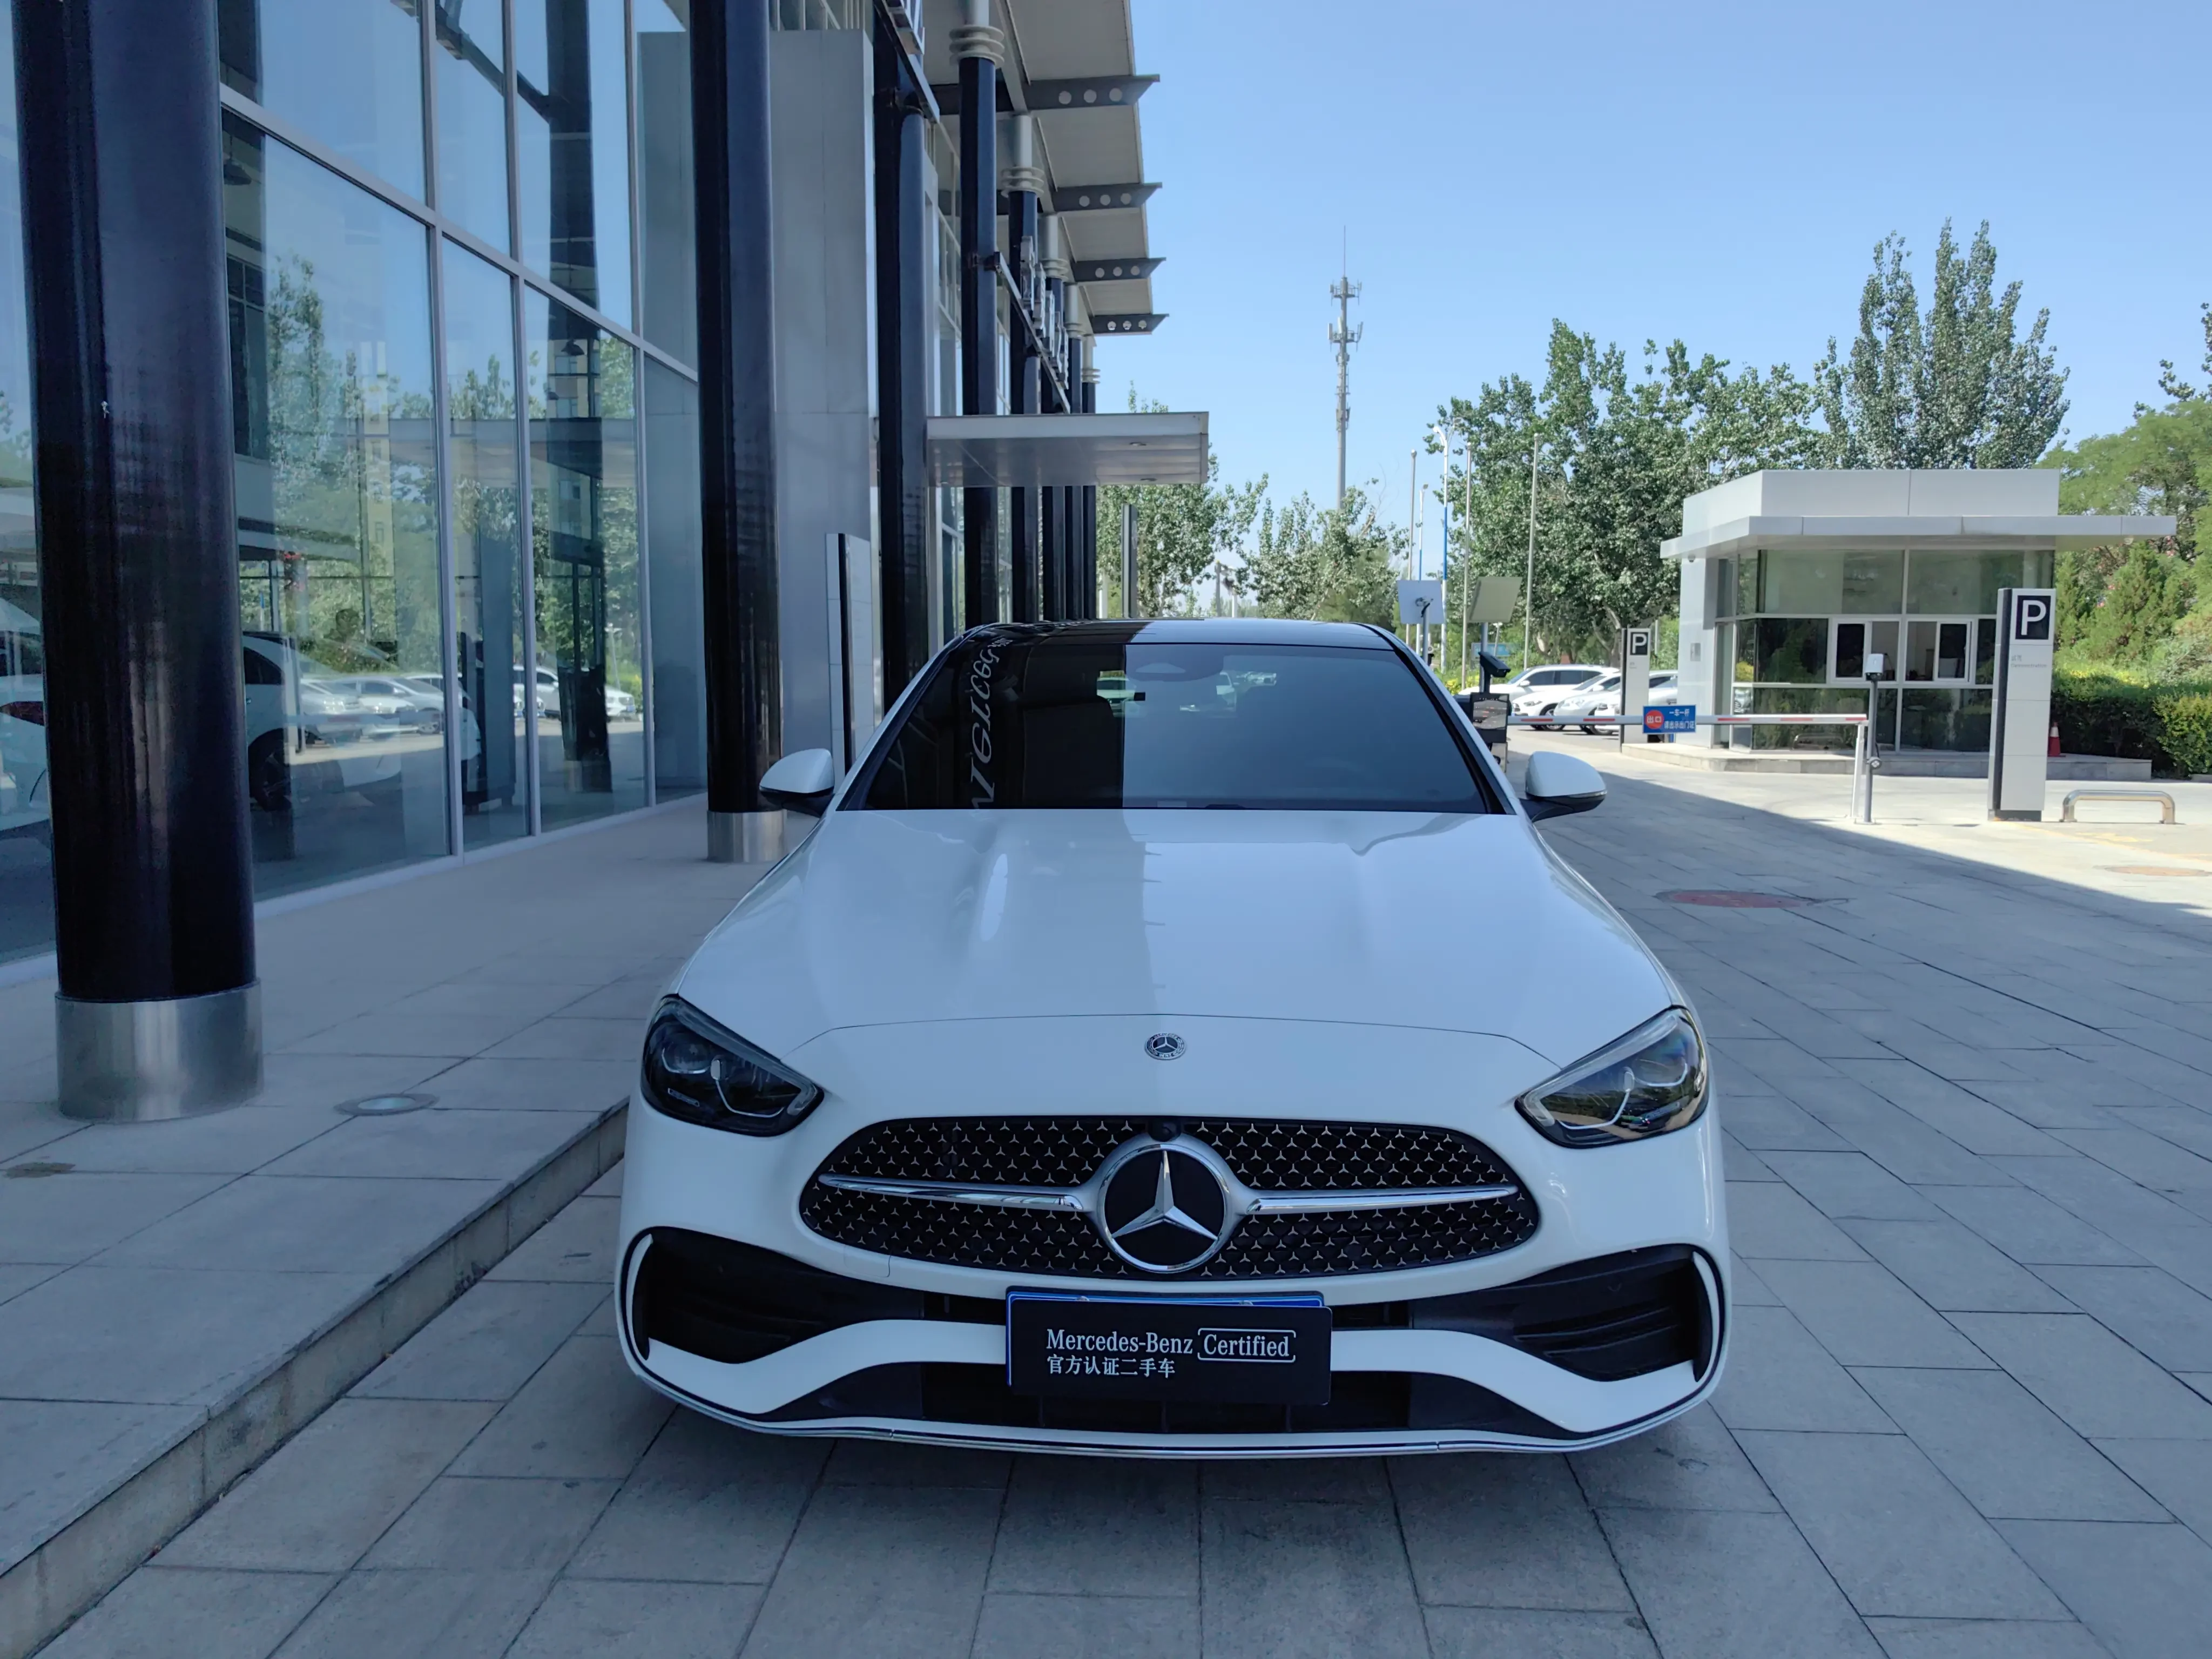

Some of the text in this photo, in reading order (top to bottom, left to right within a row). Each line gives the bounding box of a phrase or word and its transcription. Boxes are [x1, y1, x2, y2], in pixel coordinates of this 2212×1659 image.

[2021, 599, 2047, 636] P
[1632, 633, 1647, 654] P
[1046, 1328, 1290, 1357] Mercedes-Benz Certified
[1047, 1354, 1175, 1378] 官方认证二手车
